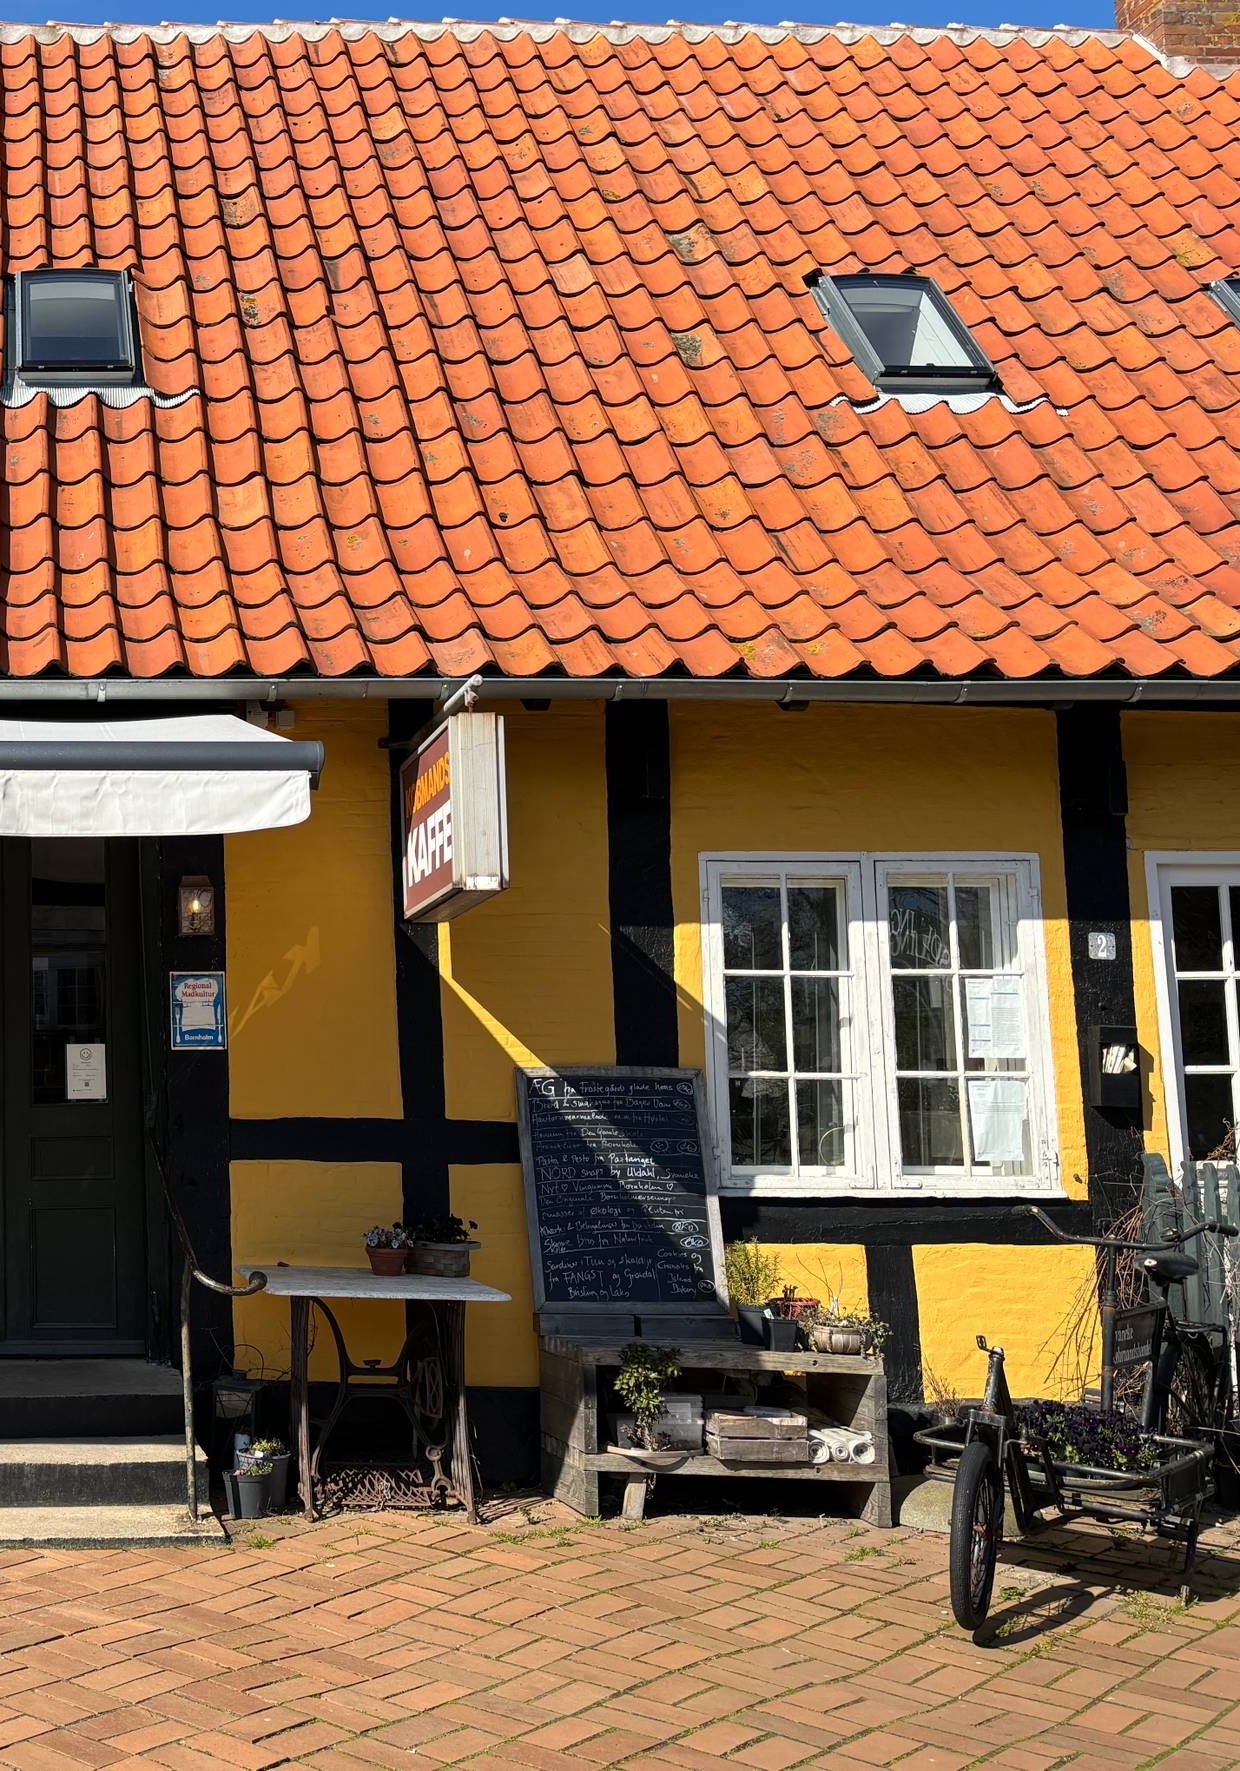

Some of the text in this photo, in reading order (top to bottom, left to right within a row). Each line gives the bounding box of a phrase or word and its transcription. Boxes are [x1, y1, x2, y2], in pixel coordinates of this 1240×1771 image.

[408, 800, 452, 887] KAFFE
[1097, 934, 1107, 957] 2
[184, 982, 212, 990] Regional
[529, 1079, 555, 1096] ÆG
[562, 1270, 604, 1287] FANGST
